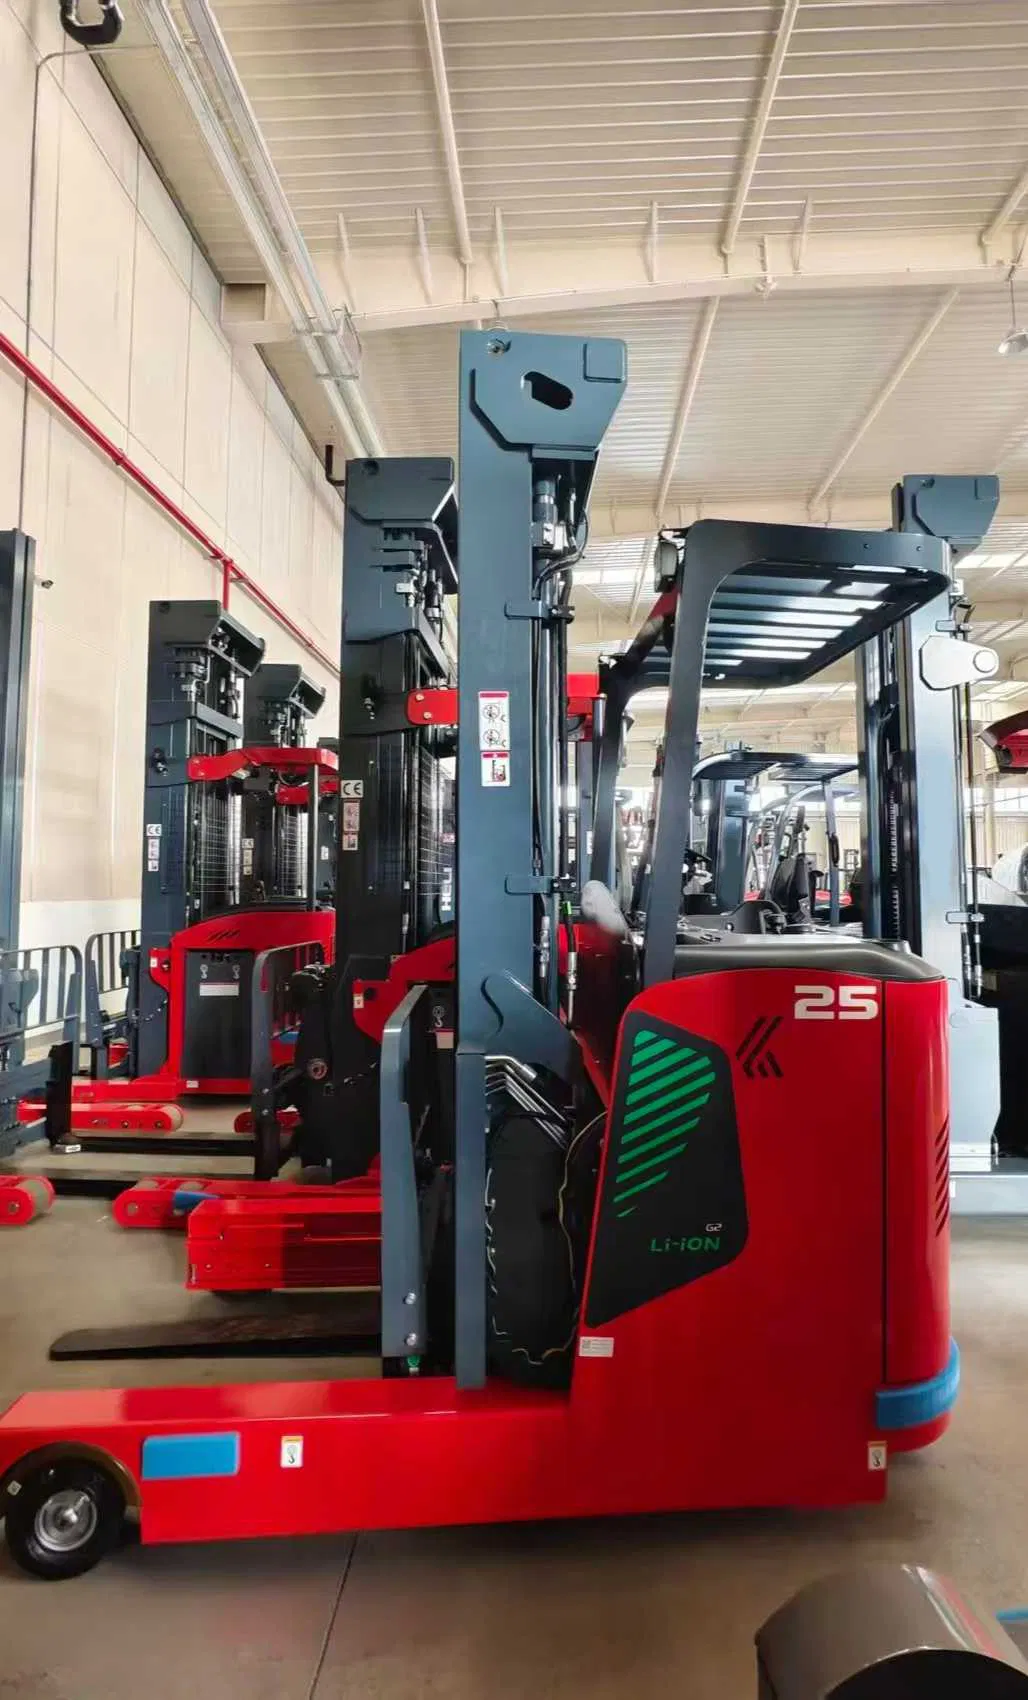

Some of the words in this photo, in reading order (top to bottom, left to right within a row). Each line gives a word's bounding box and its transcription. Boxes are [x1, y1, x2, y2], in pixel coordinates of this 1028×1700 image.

[343, 782, 361, 795] CE
[794, 985, 879, 1020] 25
[705, 1223, 723, 1232] G2
